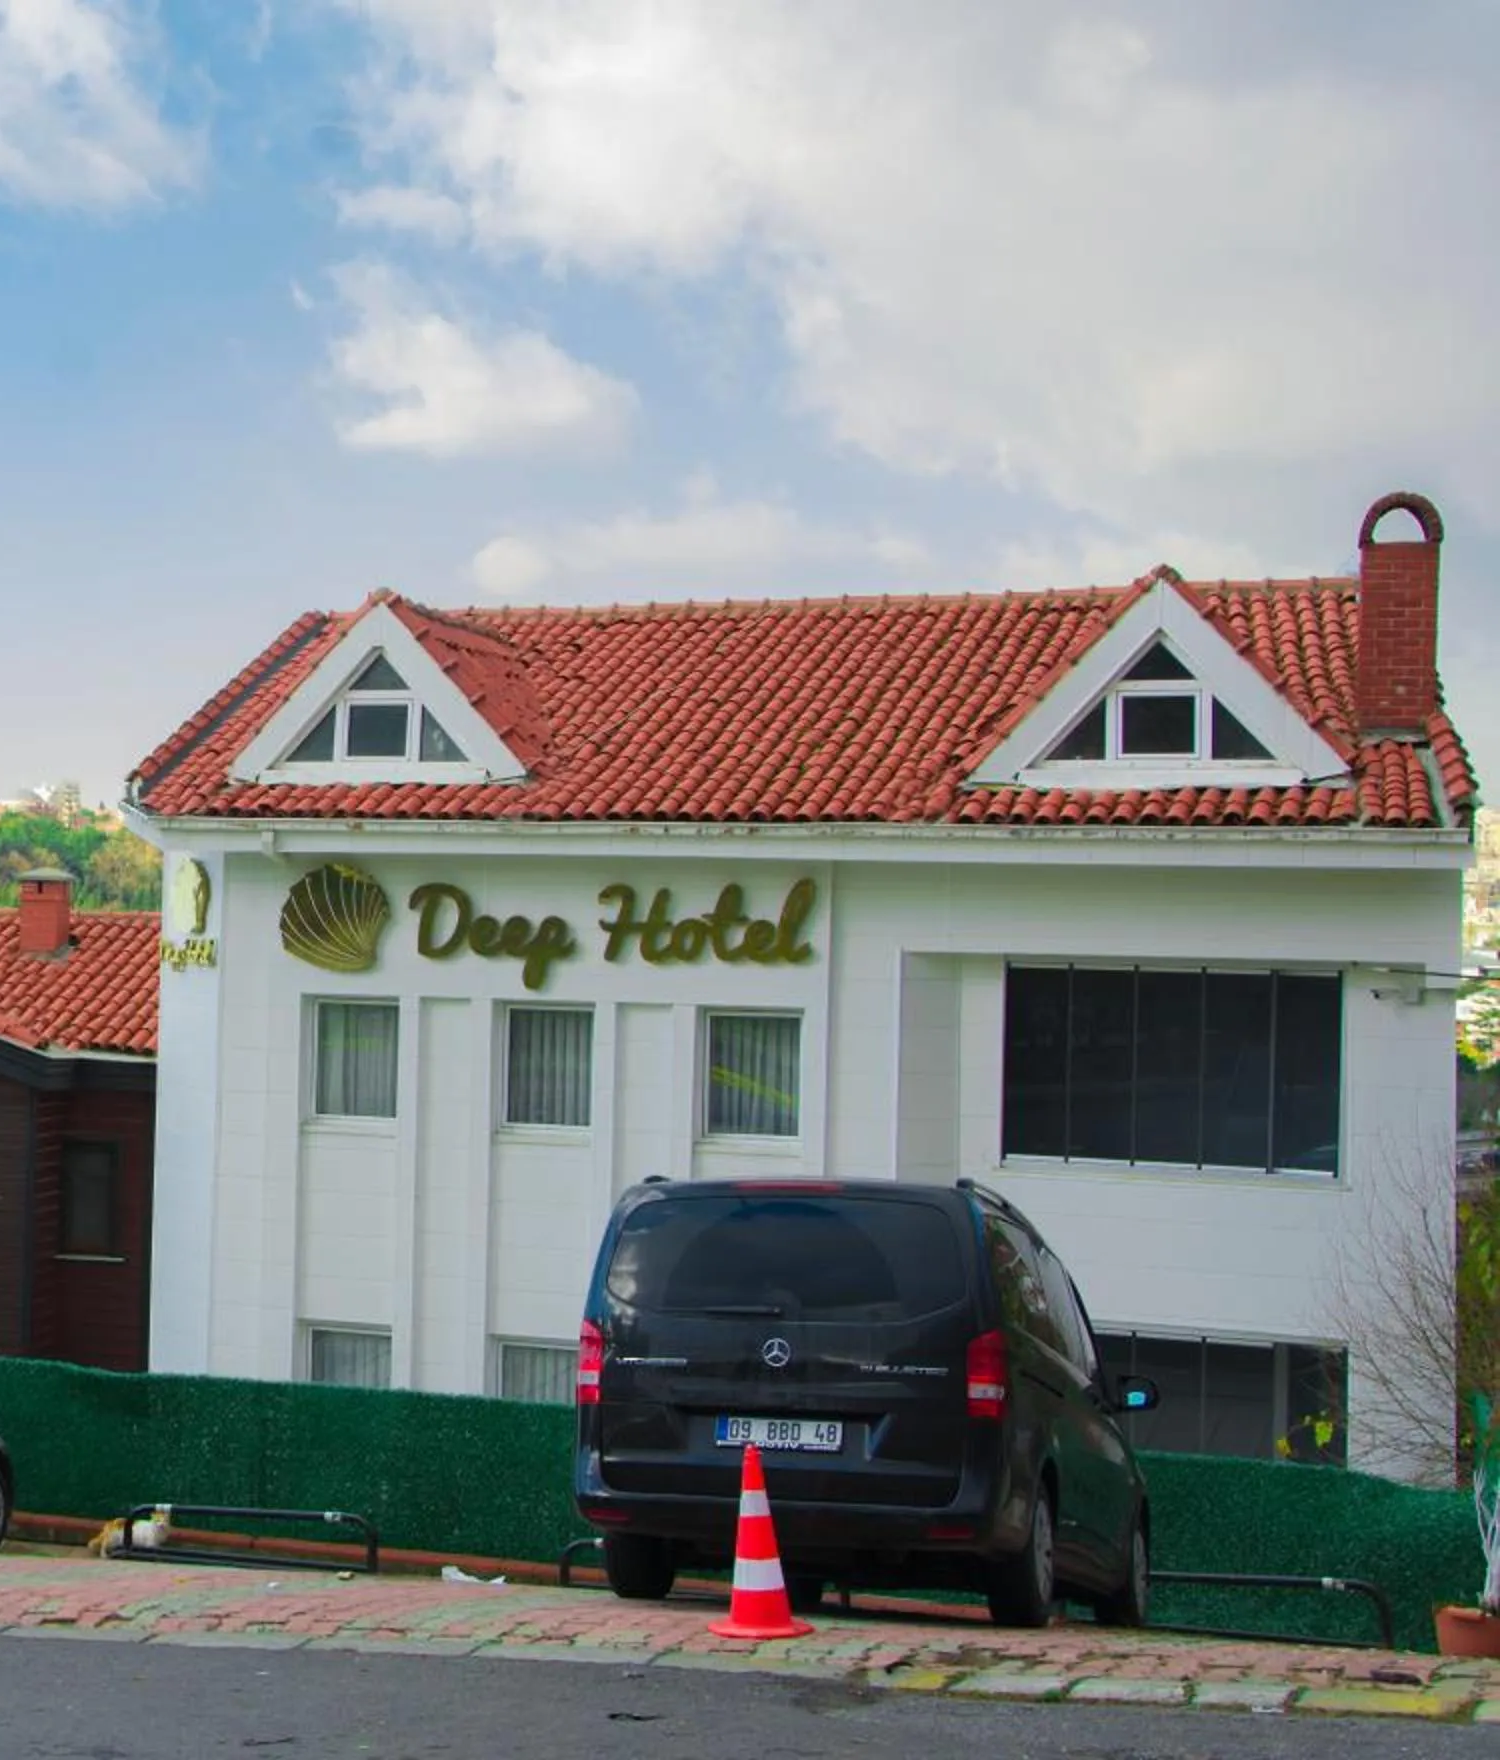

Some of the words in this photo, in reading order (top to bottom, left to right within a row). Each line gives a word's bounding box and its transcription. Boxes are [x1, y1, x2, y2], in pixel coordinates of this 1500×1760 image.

[409, 881, 576, 991] Deep
[598, 876, 817, 964] Hotel
[729, 1420, 751, 1439] 09
[815, 1423, 837, 1443] 48
